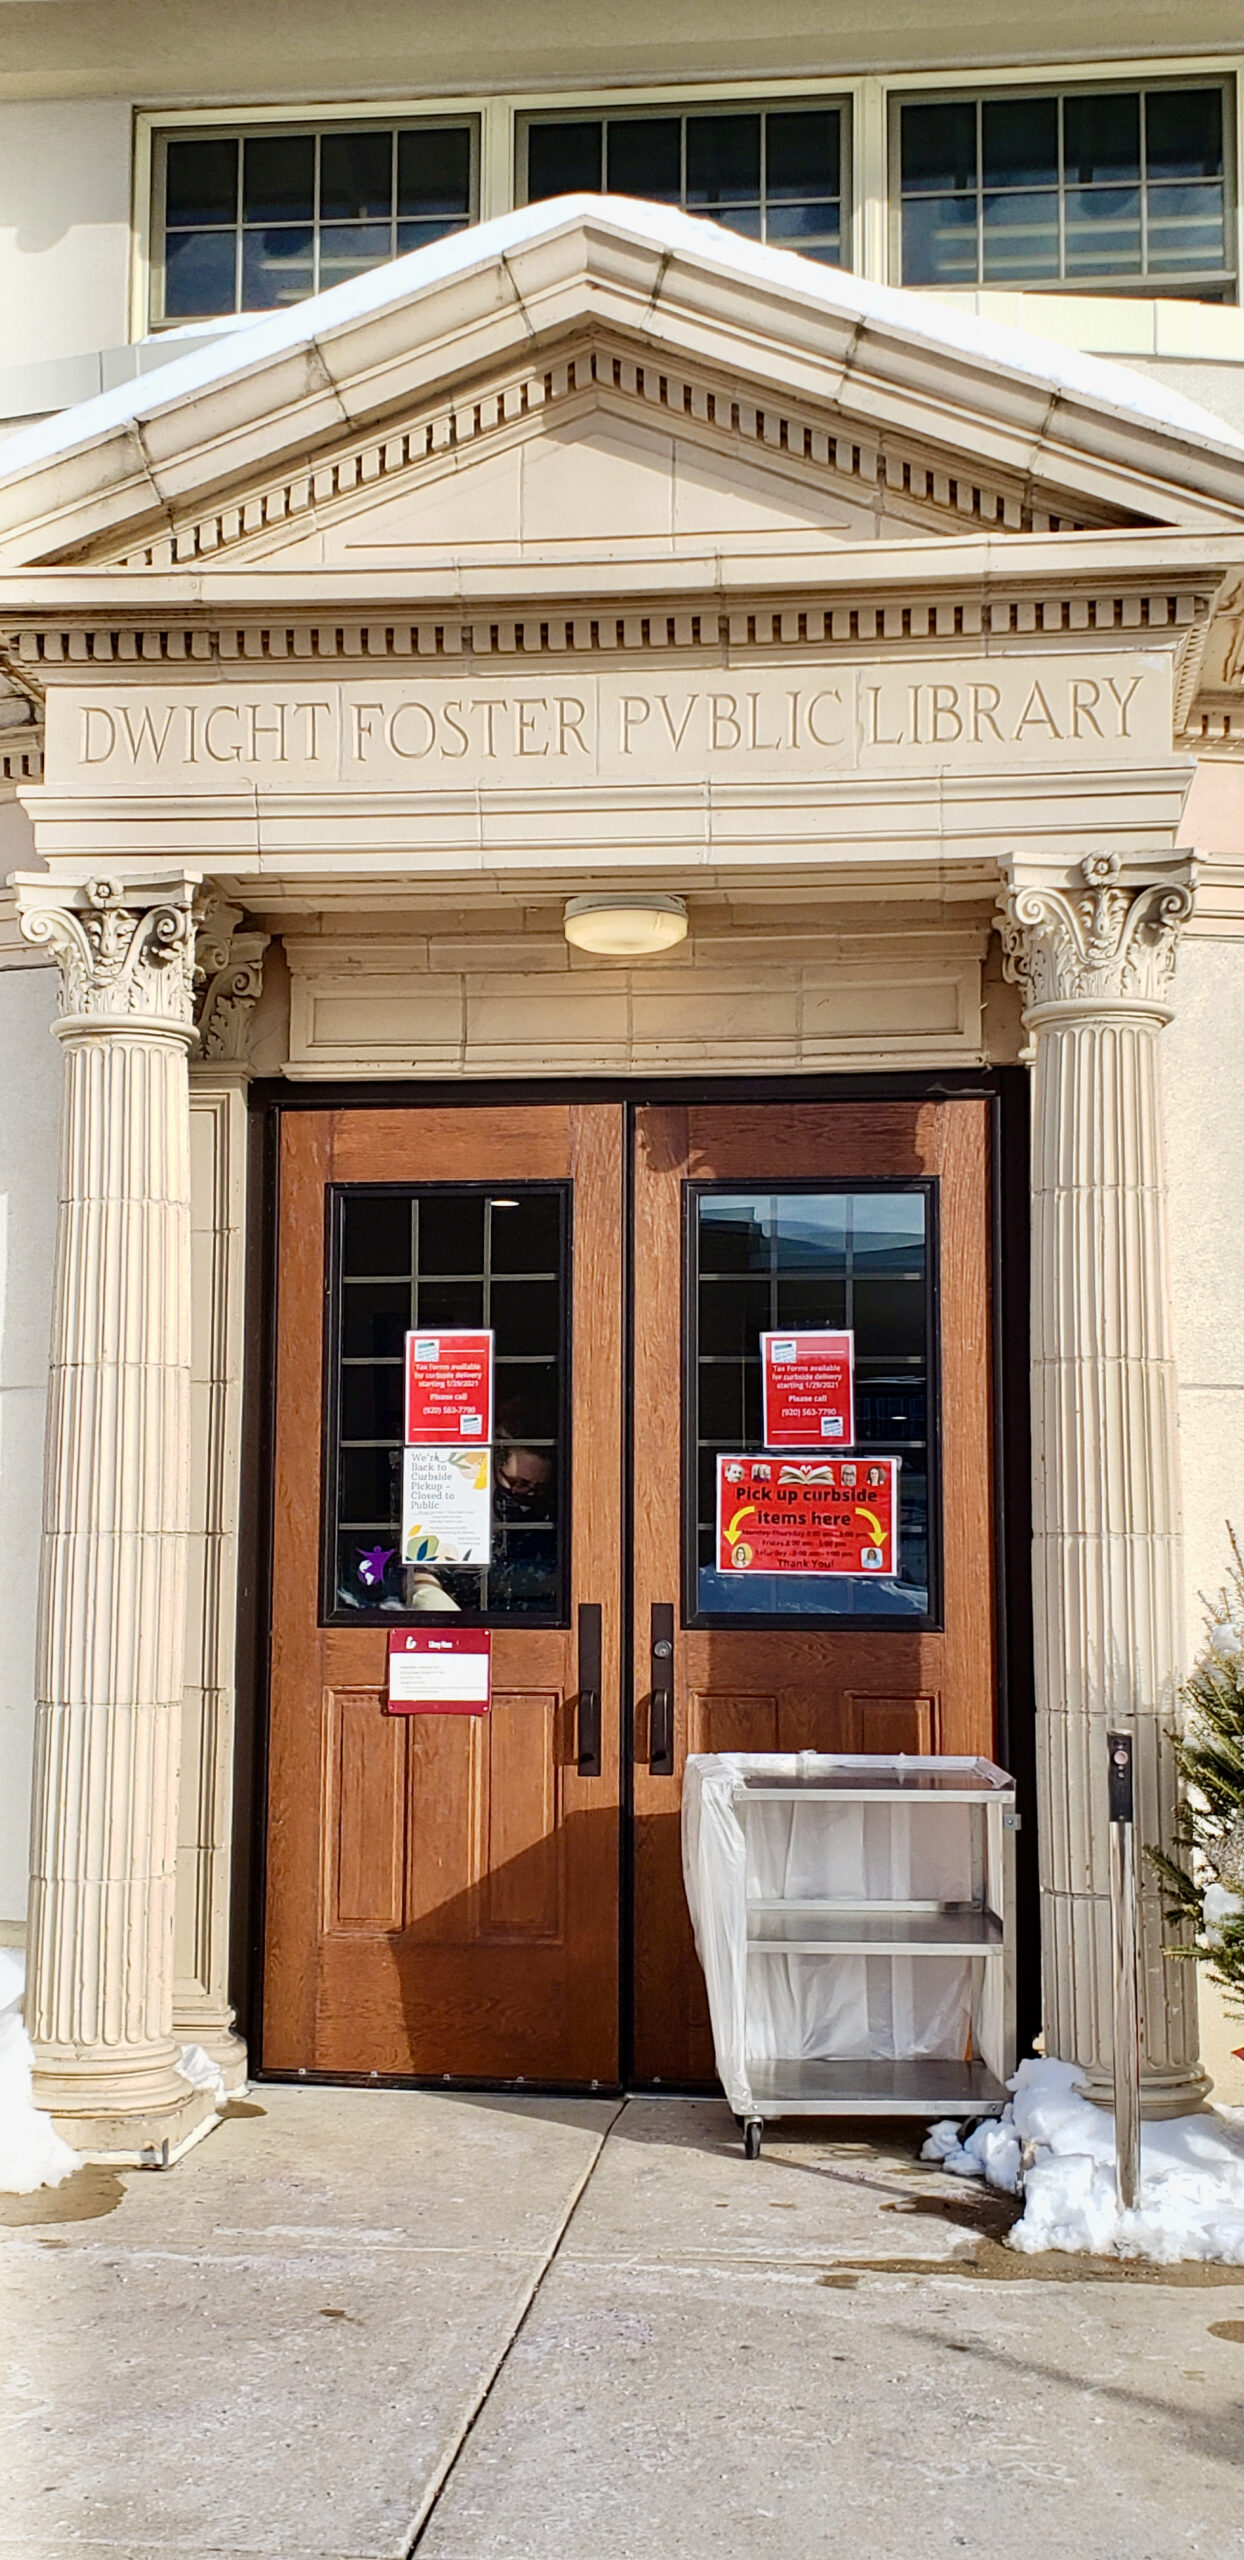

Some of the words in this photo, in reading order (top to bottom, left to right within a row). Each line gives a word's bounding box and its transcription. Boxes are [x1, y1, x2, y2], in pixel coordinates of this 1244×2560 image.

[77, 702, 332, 765] DWIGHT
[349, 697, 591, 762] FOSTER
[618, 690, 845, 755] PVBLIC
[865, 675, 1144, 747] LIBRARY
[456, 1372, 482, 1380] delivery
[814, 1374, 842, 1382] delivery
[418, 1381, 445, 1389] starting
[777, 1382, 804, 1390] starting
[430, 1393, 453, 1401] Please
[455, 1393, 468, 1401] call
[423, 1407, 441, 1415] (920)
[782, 1408, 801, 1417] (920)
[411, 1463, 435, 1471] Back
[437, 1463, 447, 1471] to
[411, 1473, 453, 1481] Curbside
[411, 1482, 443, 1492] Pickup
[411, 1492, 442, 1500] Closed
[445, 1492, 455, 1500] to
[736, 1487, 771, 1501] Pick
[777, 1490, 798, 1505] up
[803, 1488, 878, 1503] curbside
[411, 1501, 439, 1509] Public
[758, 1510, 806, 1525] items
[812, 1511, 852, 1526] here
[778, 1559, 809, 1568] Thank
[811, 1560, 835, 1568] You!
